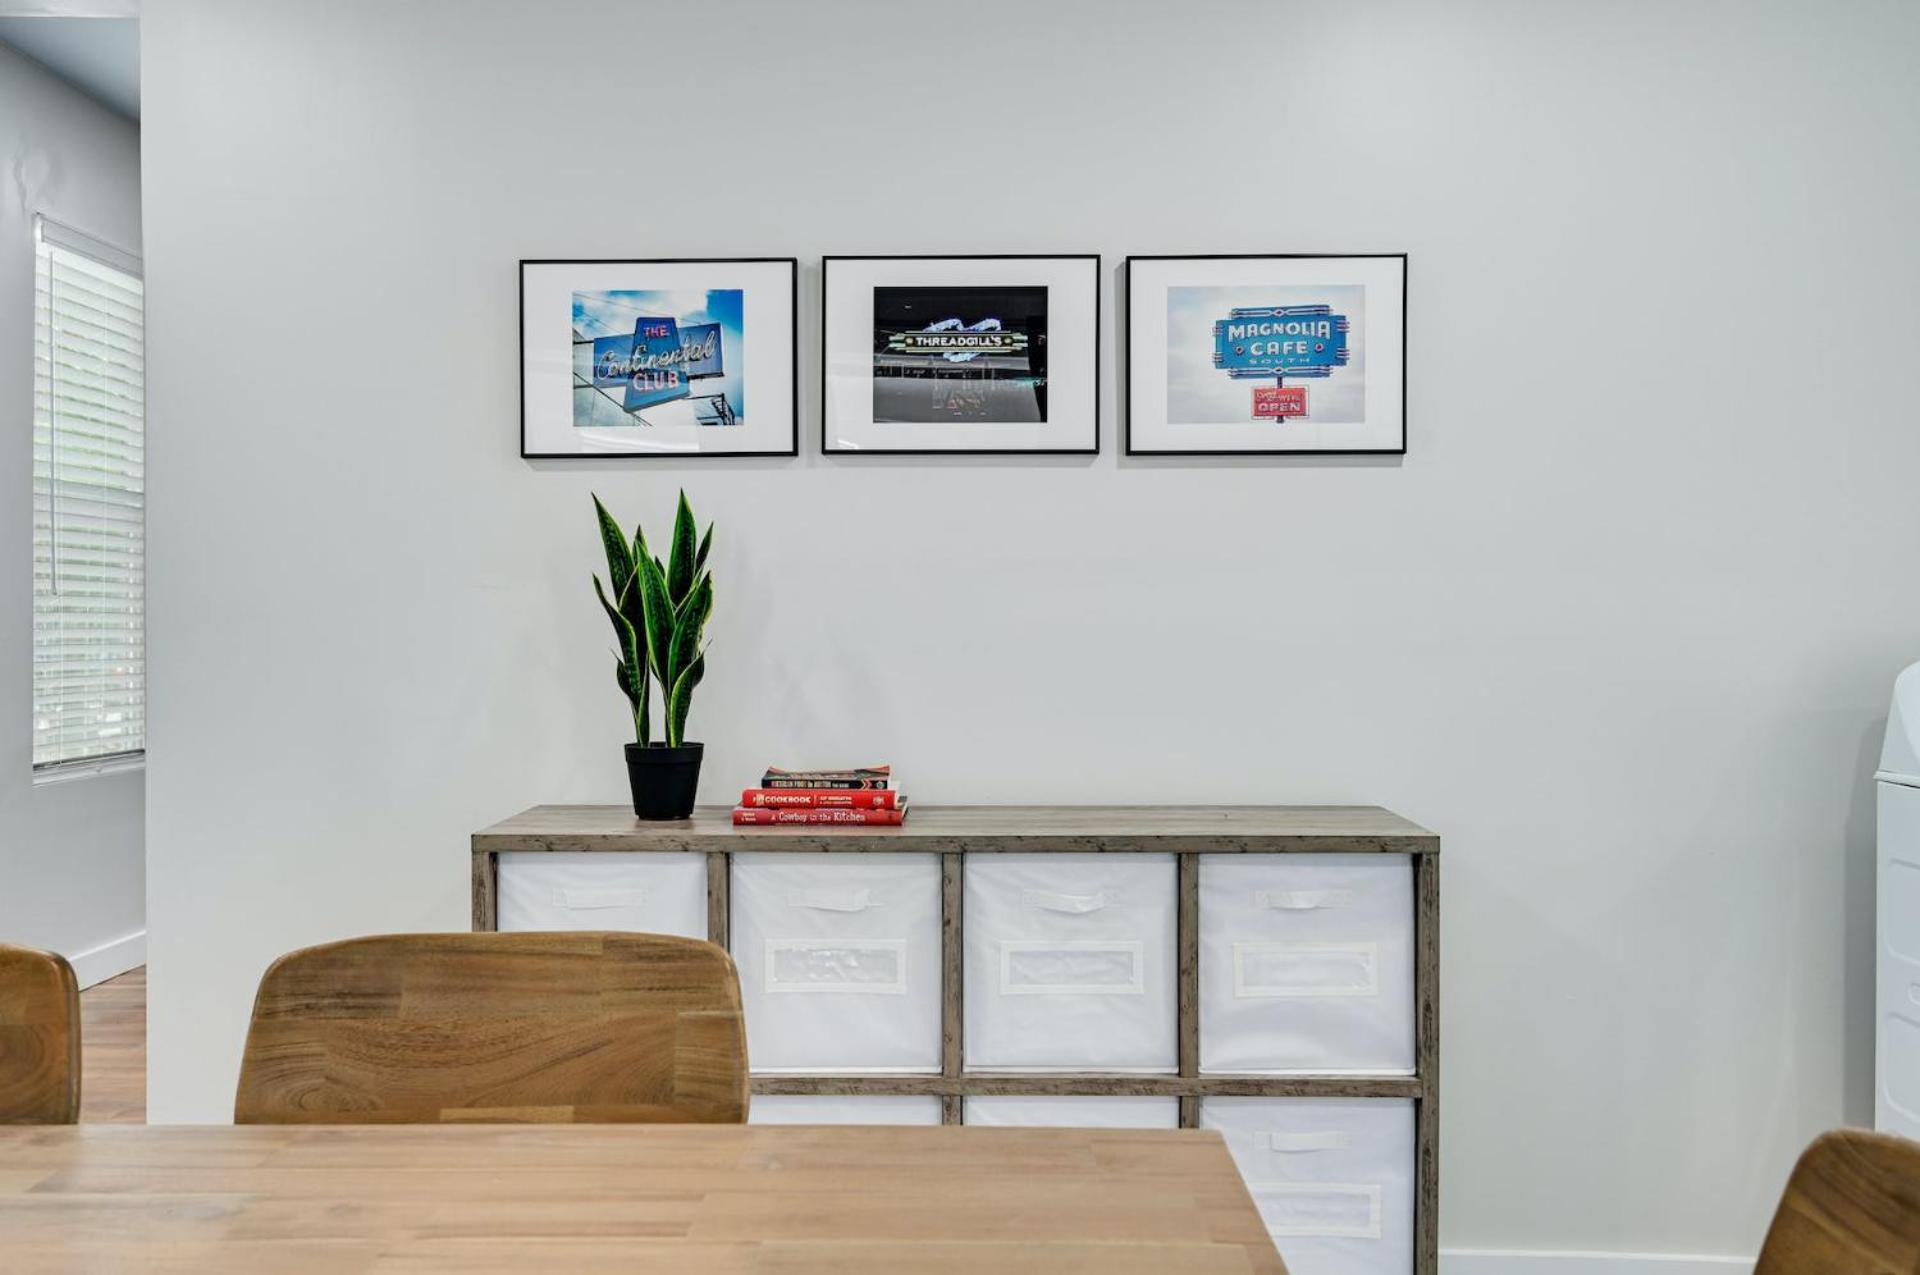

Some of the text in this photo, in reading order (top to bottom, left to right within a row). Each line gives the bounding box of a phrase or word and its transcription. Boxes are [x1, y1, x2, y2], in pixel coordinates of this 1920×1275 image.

[644, 326, 669, 338] THE
[1228, 321, 1330, 342] MAGNOLIA
[915, 335, 1003, 347] THREADGILL'S
[1250, 341, 1309, 356] CAFE
[598, 331, 716, 380] Continental
[633, 371, 679, 392] CLUB
[1258, 402, 1300, 412] OPEN
[764, 796, 811, 804] COOKBOOK
[778, 811, 807, 823] Cowboy
[819, 812, 831, 821] the
[833, 811, 866, 822] Kitchen
